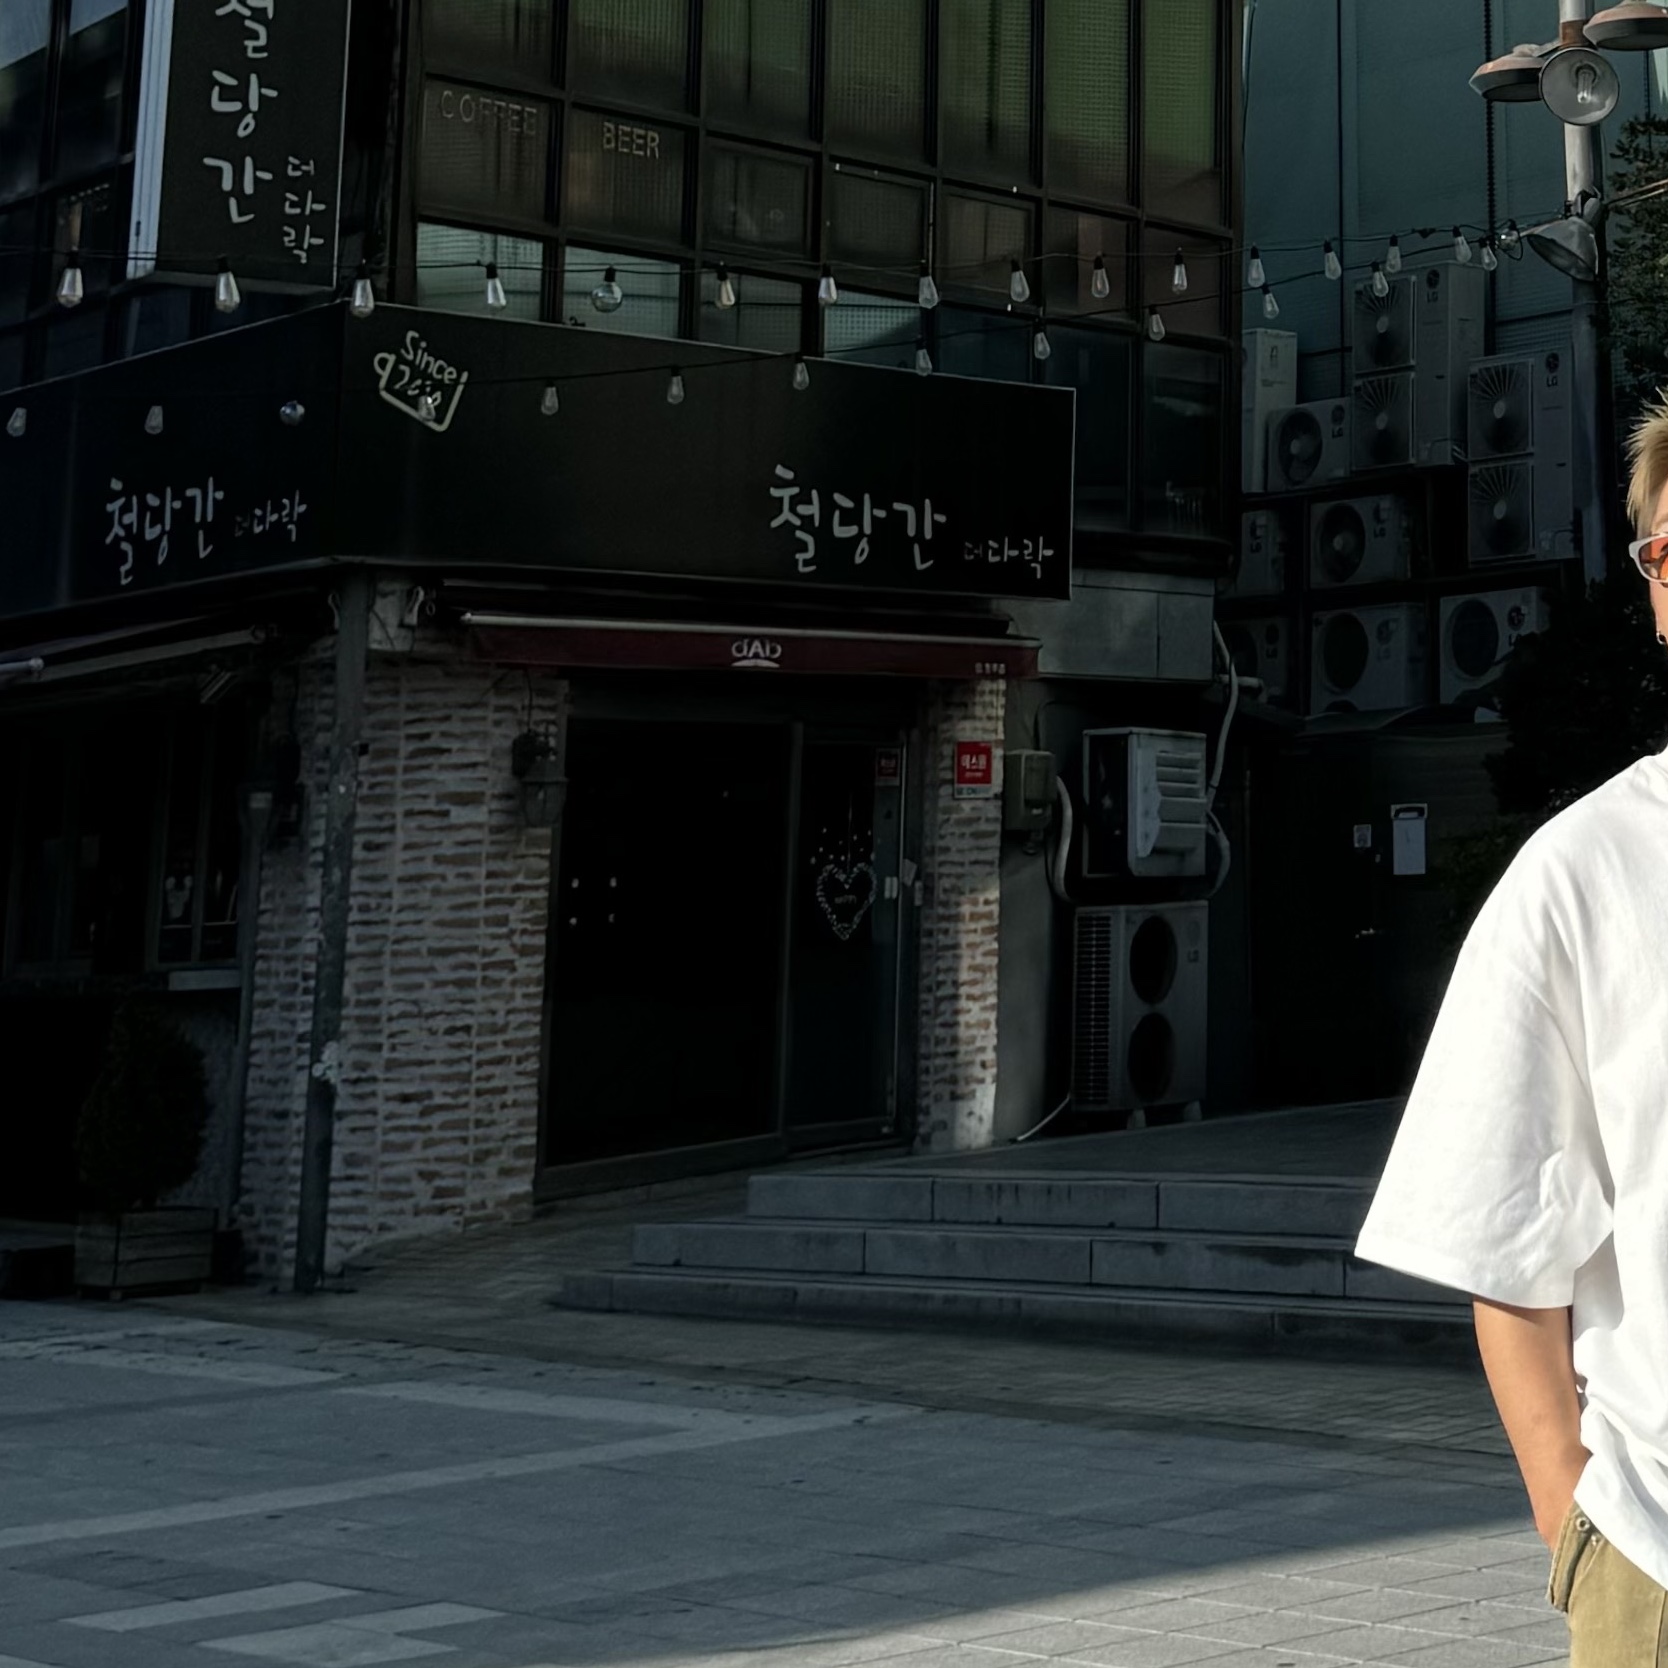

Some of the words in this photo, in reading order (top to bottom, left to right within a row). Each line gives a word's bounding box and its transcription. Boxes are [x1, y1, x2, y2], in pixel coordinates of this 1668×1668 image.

[602, 121, 660, 160] BEER
[400, 329, 458, 385] Since
[1546, 375, 1559, 388] LG
[104, 475, 226, 587] 철당간
[769, 463, 948, 574] 철당간
